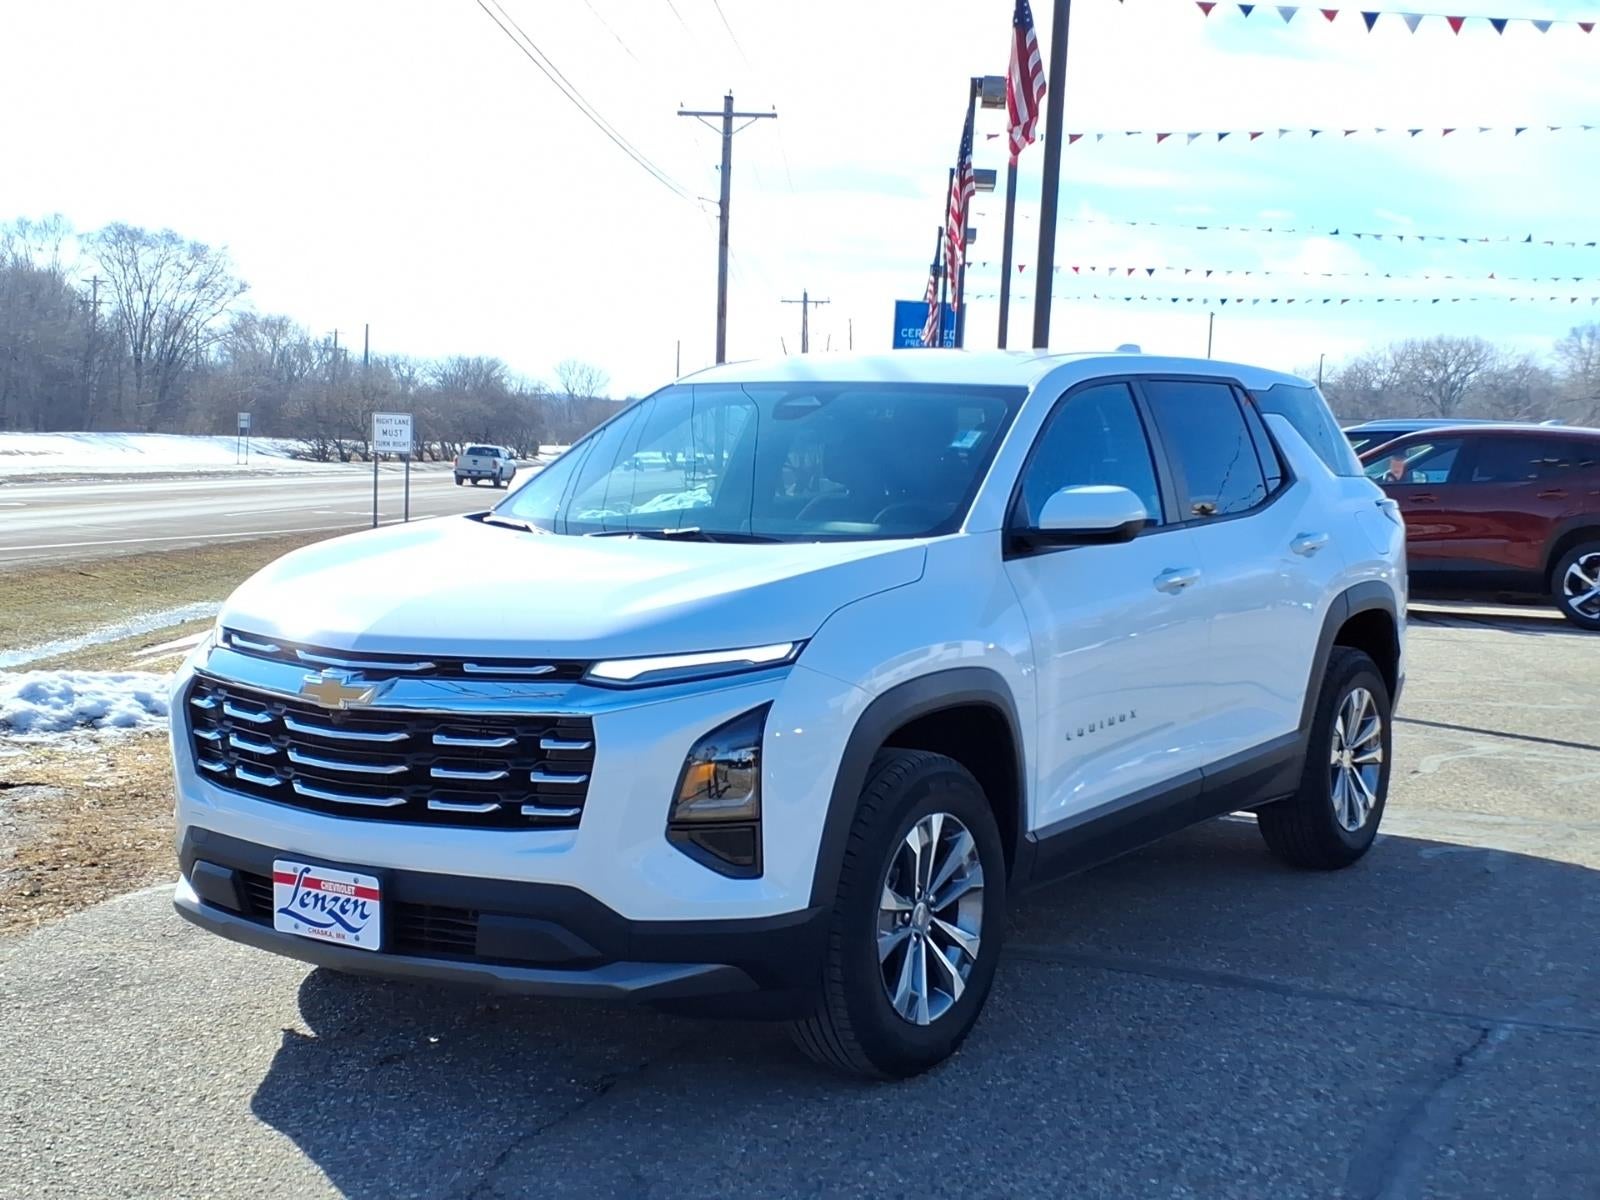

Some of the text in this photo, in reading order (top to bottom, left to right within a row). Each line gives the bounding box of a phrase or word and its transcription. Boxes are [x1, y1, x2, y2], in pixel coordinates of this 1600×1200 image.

[382, 429, 402, 437] MUST
[320, 880, 356, 895] CHEVROLET
[277, 867, 372, 933] Lenzen
[335, 932, 346, 940] MN
